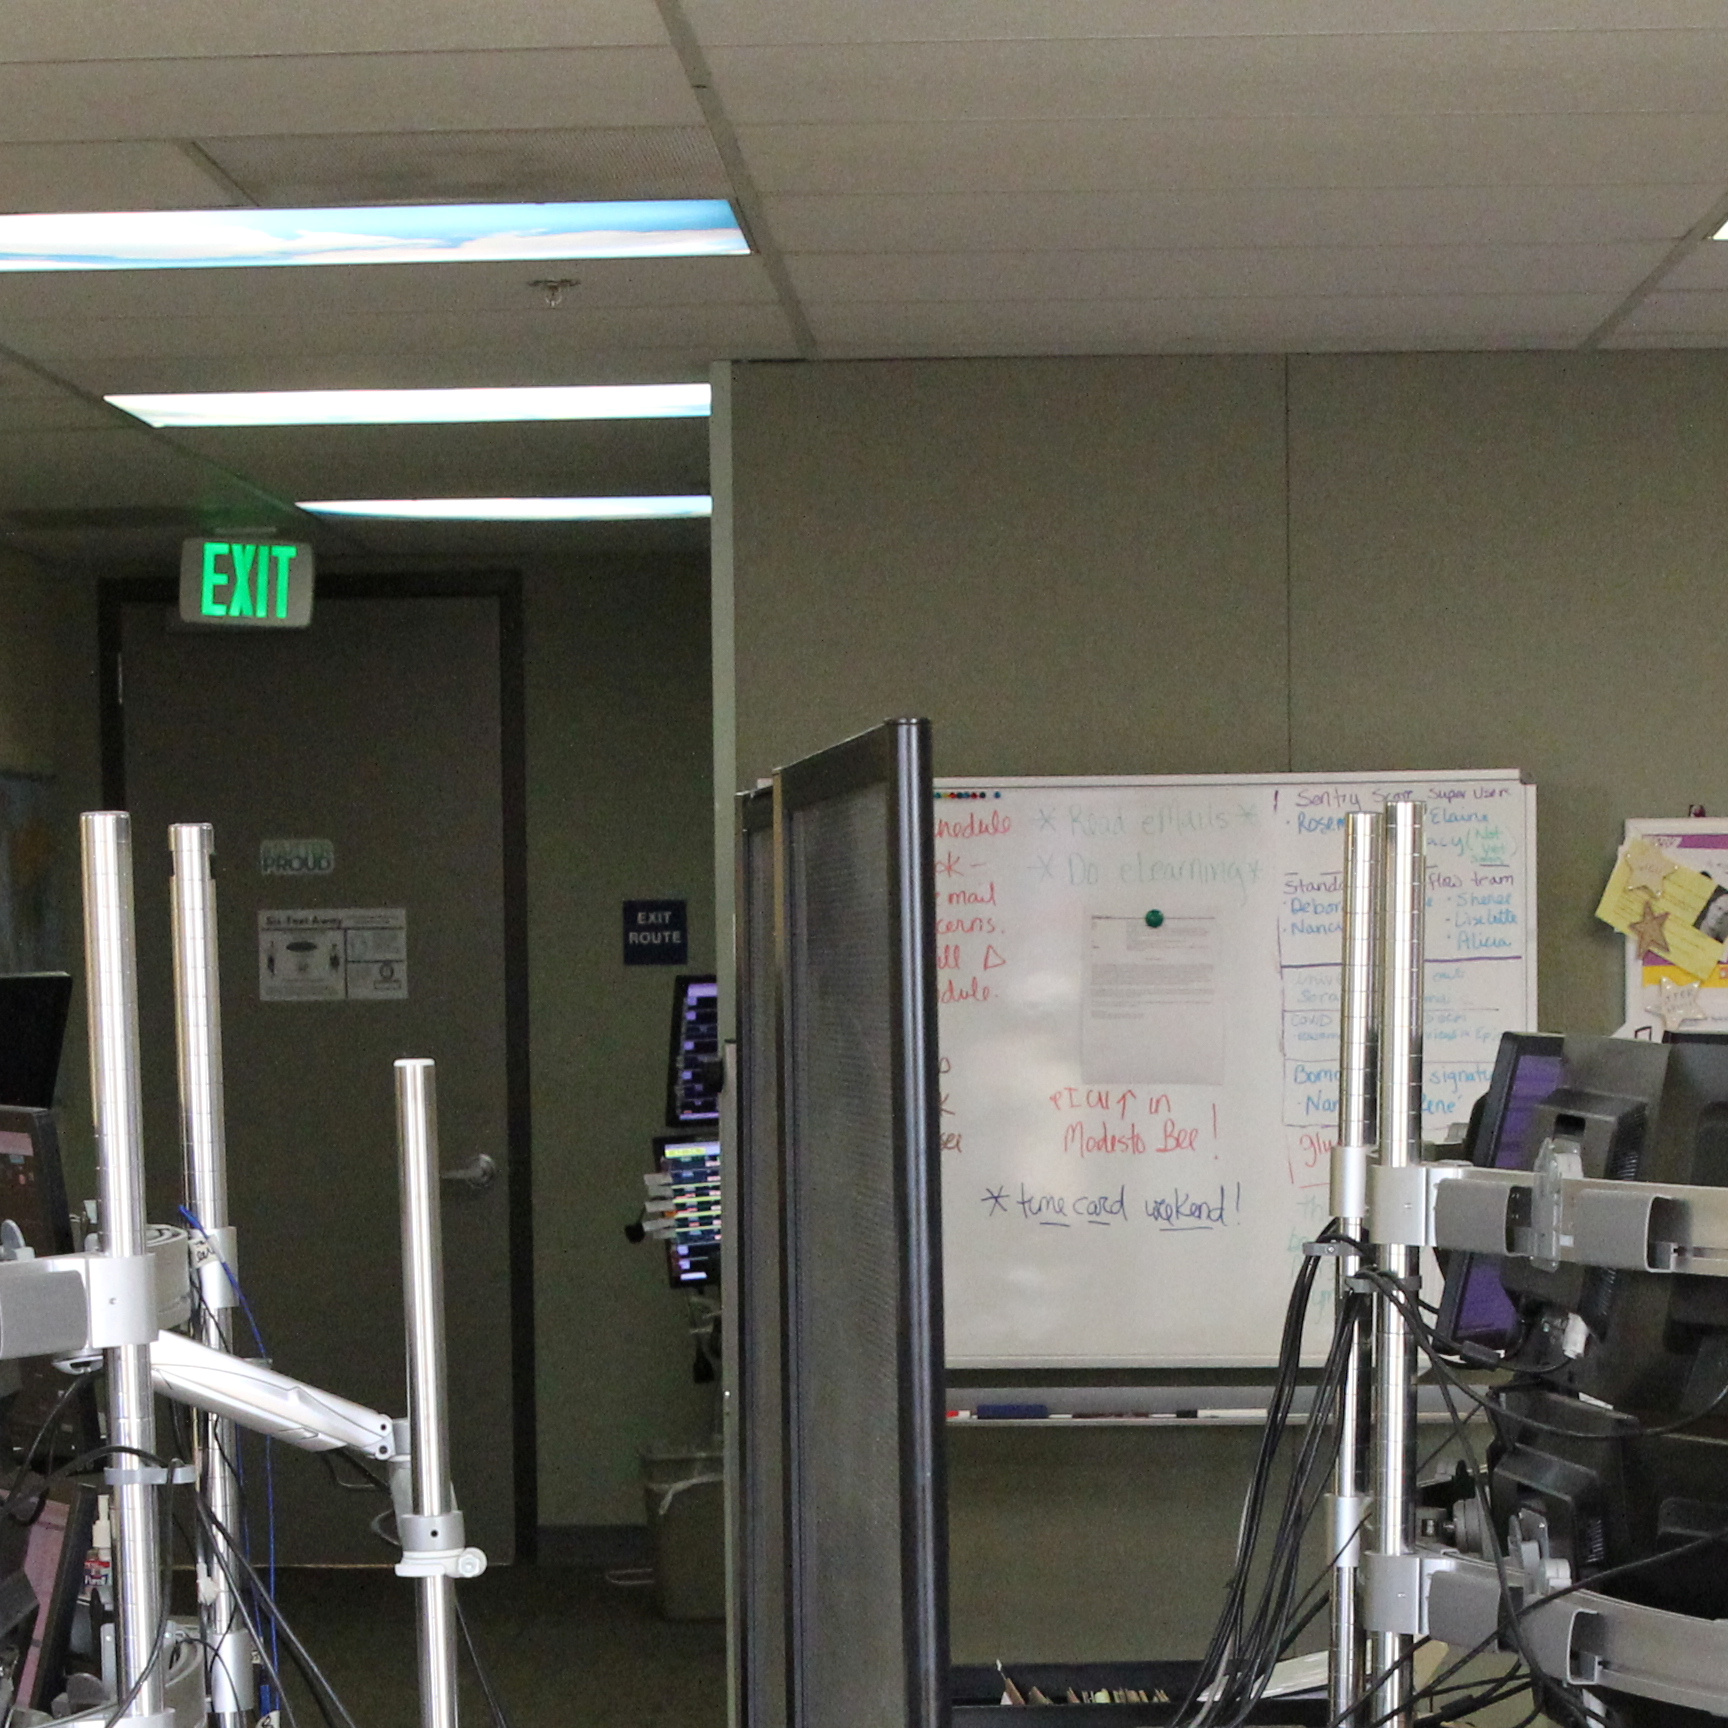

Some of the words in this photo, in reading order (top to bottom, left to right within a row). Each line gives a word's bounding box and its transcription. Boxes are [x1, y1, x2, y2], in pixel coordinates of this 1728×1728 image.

[202, 542, 298, 619] EXIT
[637, 911, 672, 925] EXIT
[629, 931, 681, 944] ROUTE
[1064, 1119, 1146, 1158] Modesto
